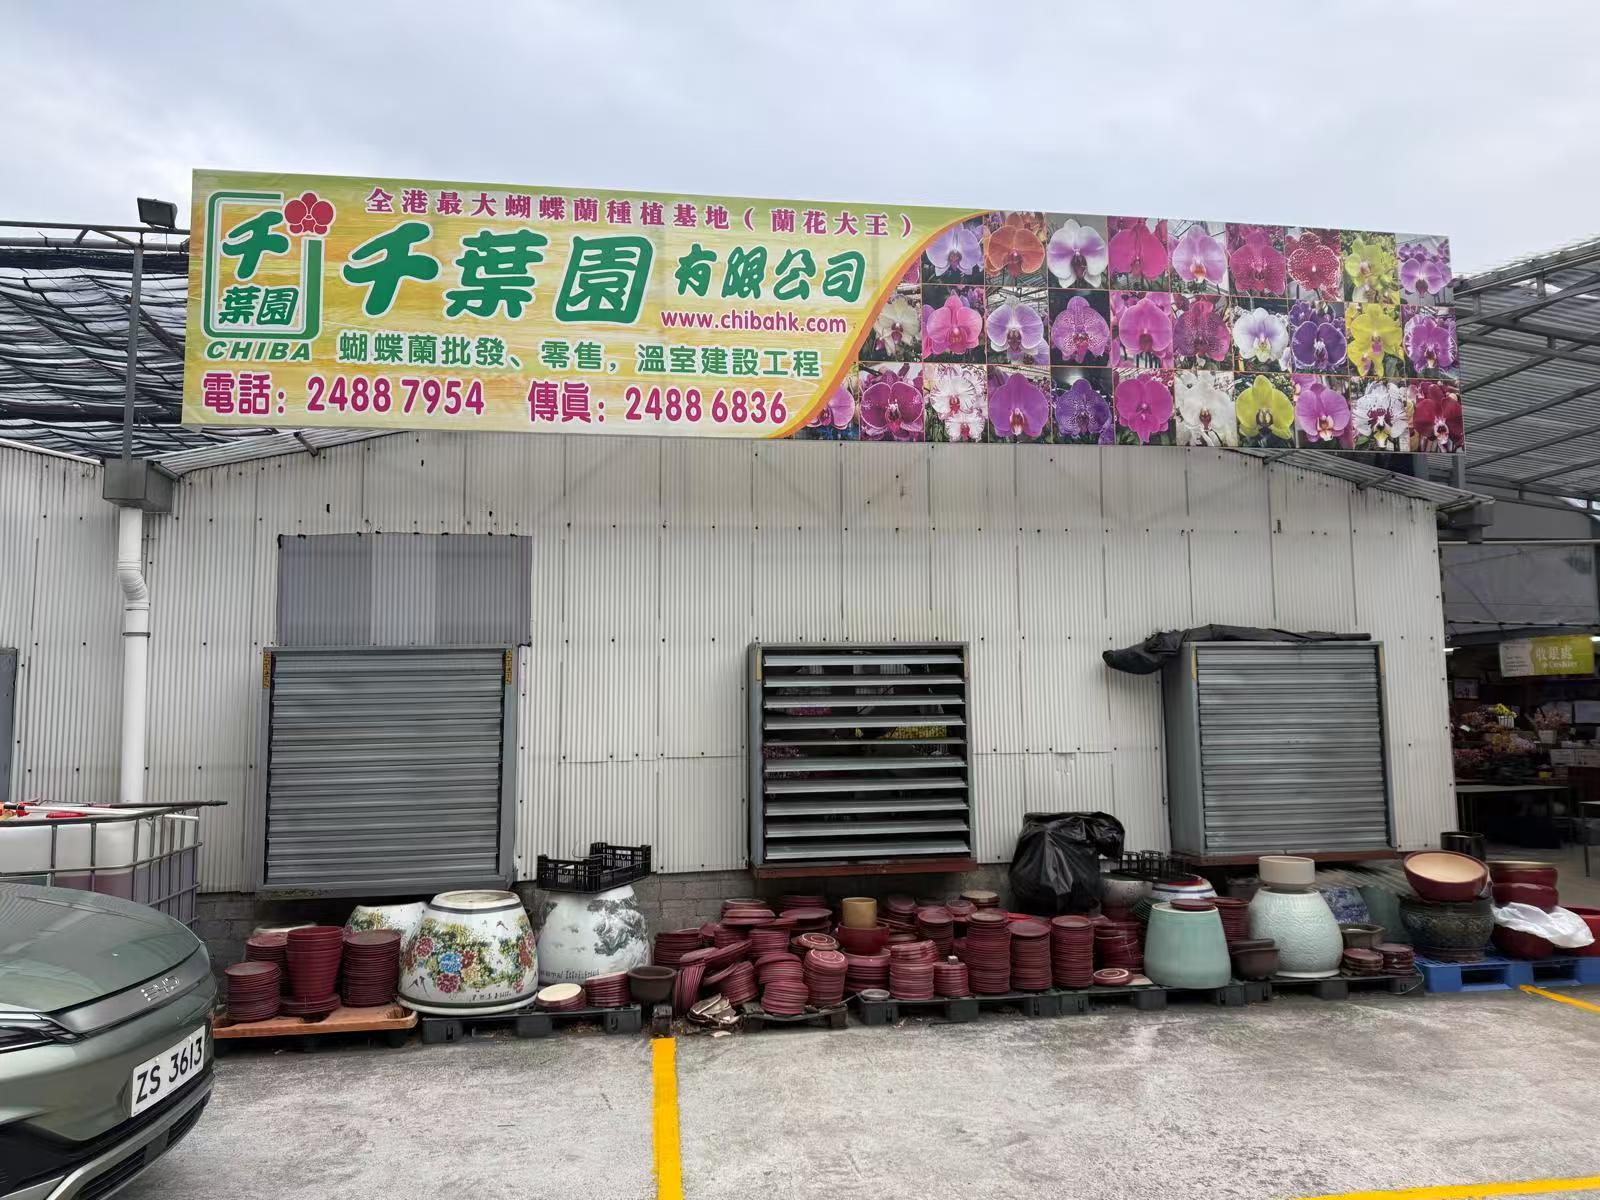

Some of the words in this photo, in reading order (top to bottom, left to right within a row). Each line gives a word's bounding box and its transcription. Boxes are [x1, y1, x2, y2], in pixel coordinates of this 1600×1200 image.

[661, 309, 847, 333] www.chibahk.com
[206, 341, 310, 361] CHIBA
[307, 377, 391, 413] 2488
[401, 379, 484, 415] 7954
[625, 387, 701, 424] 2488
[711, 390, 787, 424] 6836
[136, 1064, 161, 1104] ZS
[168, 1036, 203, 1083] 3613
